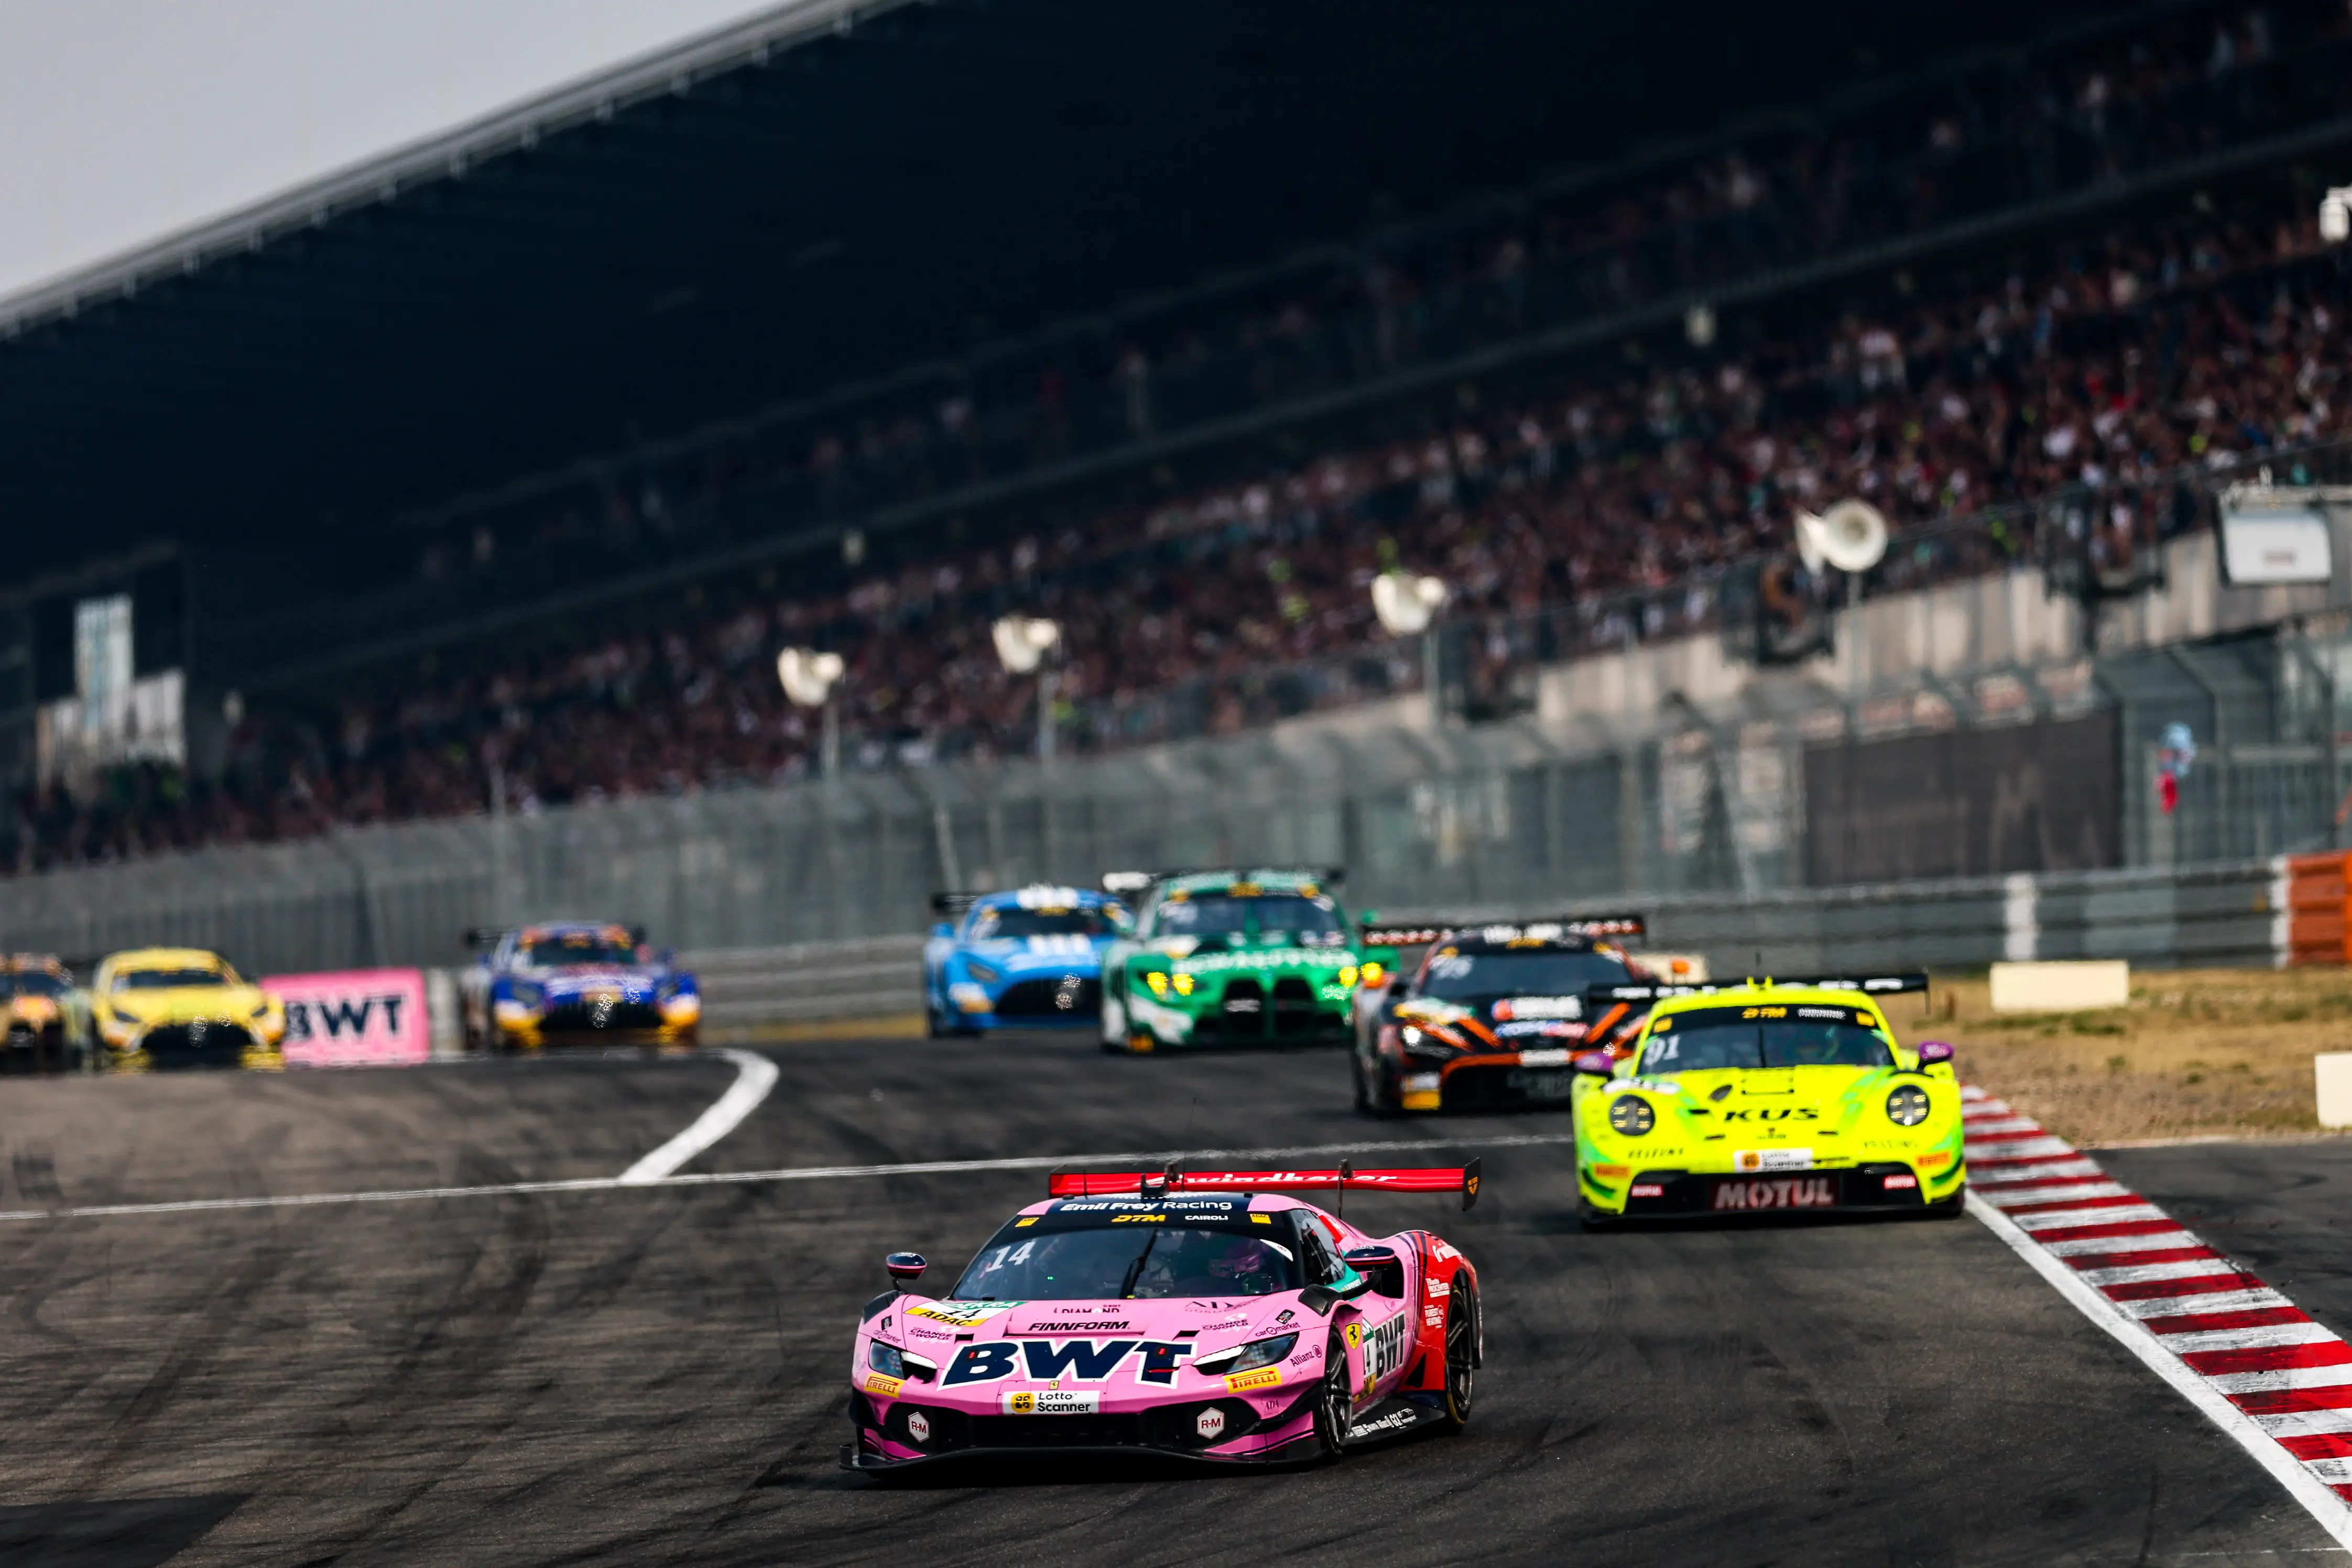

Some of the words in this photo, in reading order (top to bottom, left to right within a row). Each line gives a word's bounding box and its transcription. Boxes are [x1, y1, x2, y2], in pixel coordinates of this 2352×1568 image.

[286, 995, 401, 1038] BWT
[1644, 1035, 1680, 1066] 91
[1187, 1173, 1398, 1183] windhaer
[1715, 1177, 1833, 1208] MOTUL
[1060, 1202, 1109, 1211] Emil
[1109, 1202, 1159, 1211] Frey
[1162, 1201, 1232, 1210] Racing
[985, 1241, 1036, 1272] 14
[919, 1311, 973, 1326] ADAC
[1028, 1321, 1130, 1331] FINNFORM
[1375, 1311, 1406, 1382] BWT
[940, 1340, 1194, 1388] BWT
[1290, 1351, 1315, 1367] Allianz
[867, 1376, 899, 1393] PIRELLI
[1230, 1370, 1277, 1389] PIRELLI
[1038, 1401, 1091, 1412] Scanner
[911, 1421, 927, 1434] R-M
[1201, 1417, 1221, 1429] R-M
